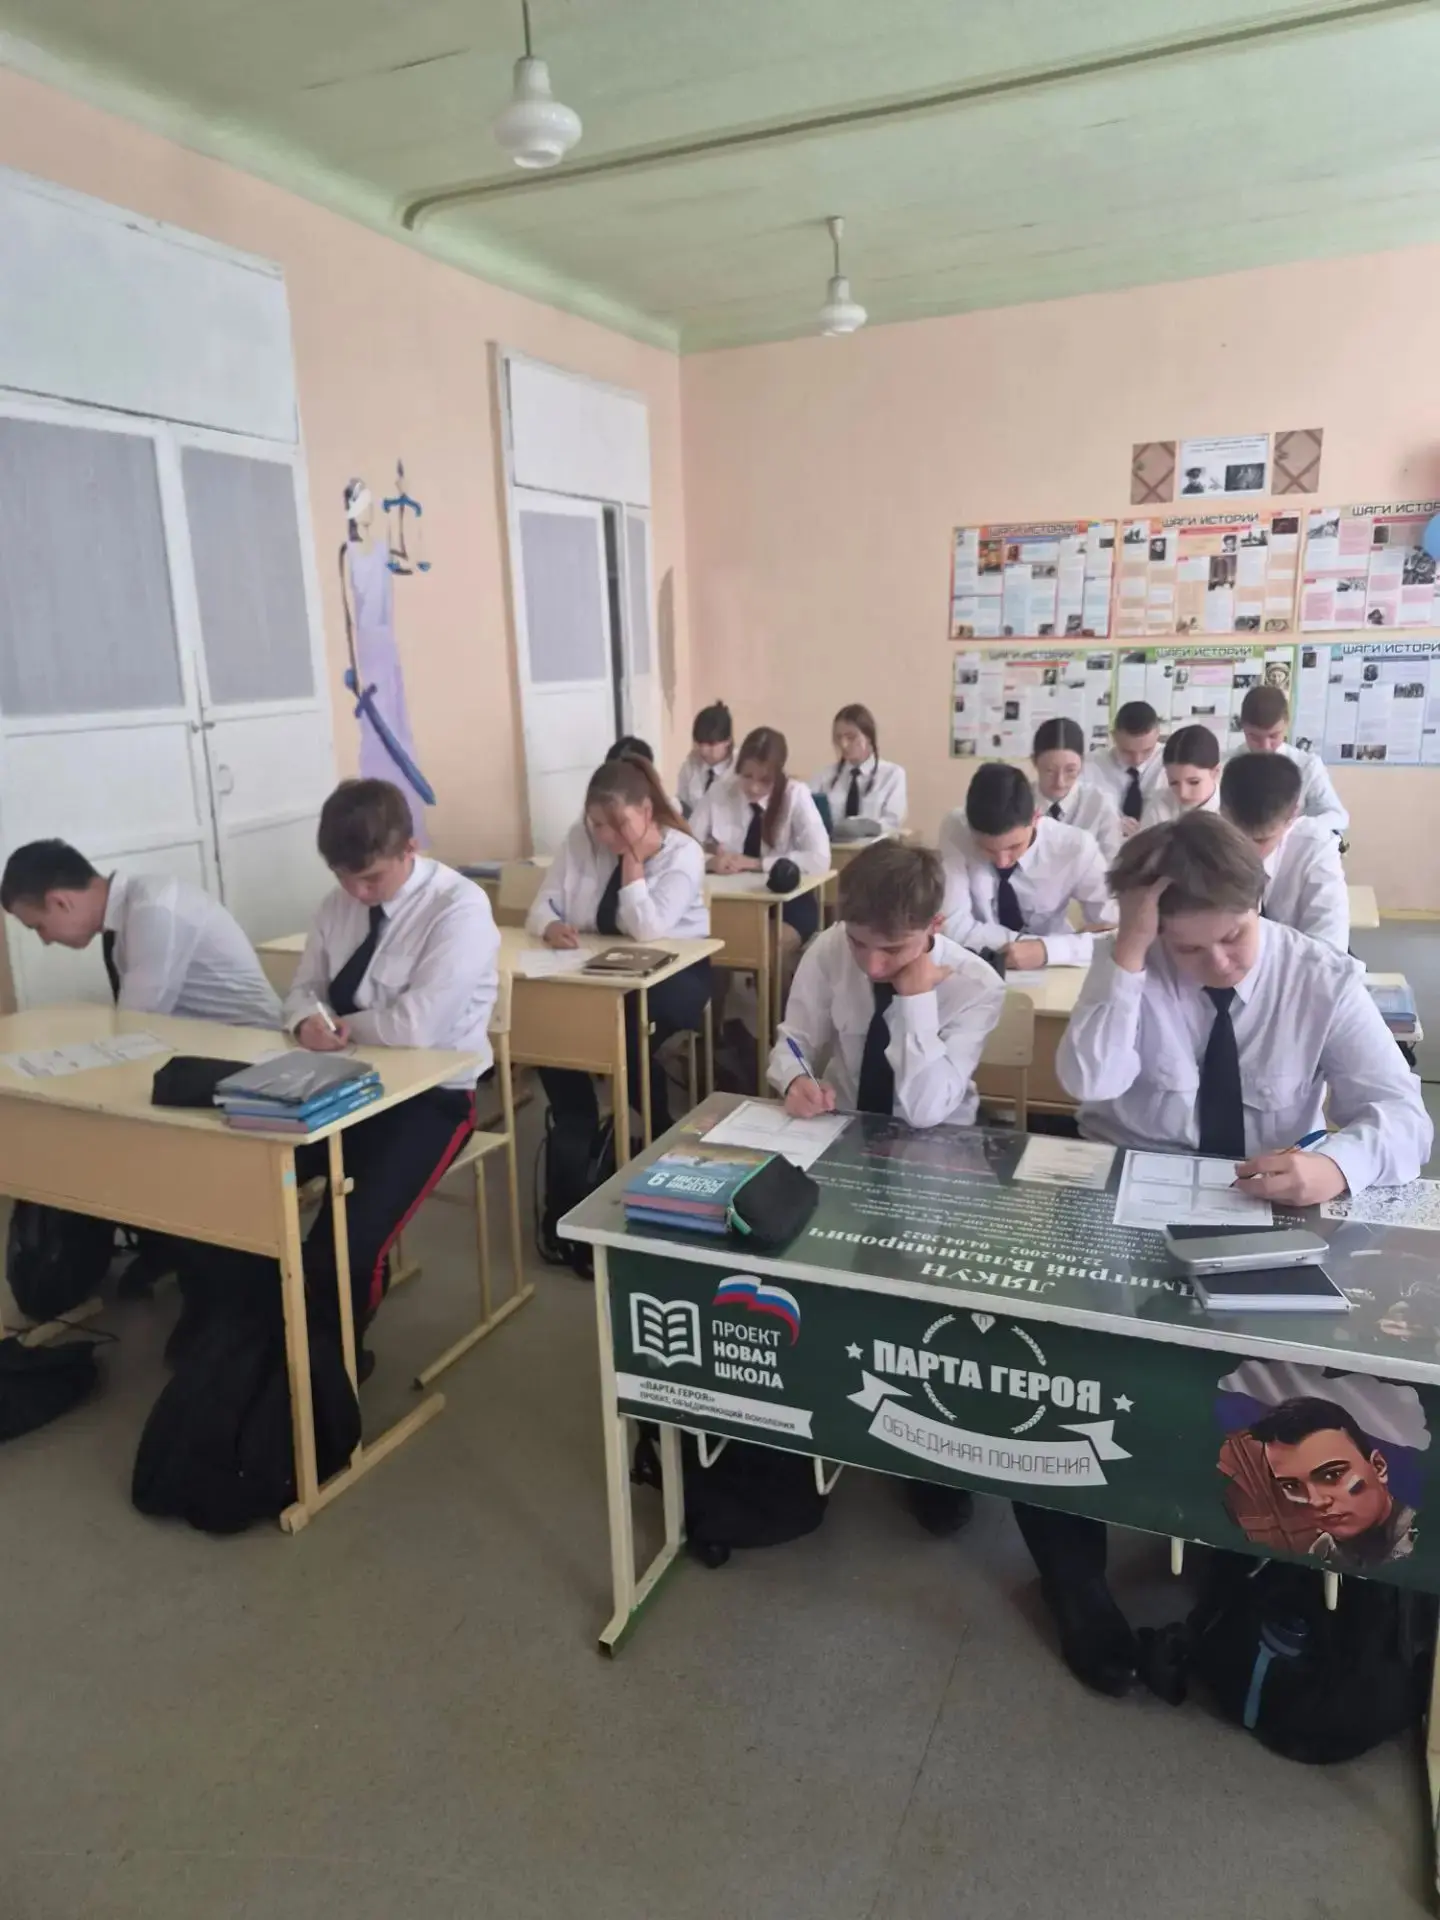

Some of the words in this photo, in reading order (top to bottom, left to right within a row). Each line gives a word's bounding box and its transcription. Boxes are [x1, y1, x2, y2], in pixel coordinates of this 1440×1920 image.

[1162, 515, 1196, 528] ШАГИ
[1200, 513, 1259, 525] ИСТОРИИ
[1352, 504, 1392, 516] ШАГИ
[1156, 647, 1191, 658] ШАГИ
[1195, 646, 1251, 657] ИСТОРИИ
[1343, 643, 1381, 654] ШАГИ
[647, 1172, 670, 1187] 9
[808, 1226, 1033, 1274] Владимирович
[903, 1230, 991, 1251] 04.04.2022
[1009, 1246, 1104, 1266] 22.06.2002
[920, 1261, 1056, 1294] ЛЯКУН
[711, 1320, 781, 1347] ПРОЕКТ
[713, 1341, 777, 1367] НОВАЯ
[714, 1361, 784, 1390] ШКОЛА
[873, 1339, 983, 1390] ПАРТА
[990, 1364, 1101, 1415] ГЕРОЯ
[640, 1381, 676, 1395] «ПАРТА
[677, 1386, 715, 1402] ГЕРОЯ»
[744, 1412, 796, 1431] ПОКОЛЕНИЯ
[882, 1414, 983, 1463] ОБЪЕДИНЯЯ
[989, 1450, 1091, 1475] ПОКОЛЕНИЯ
